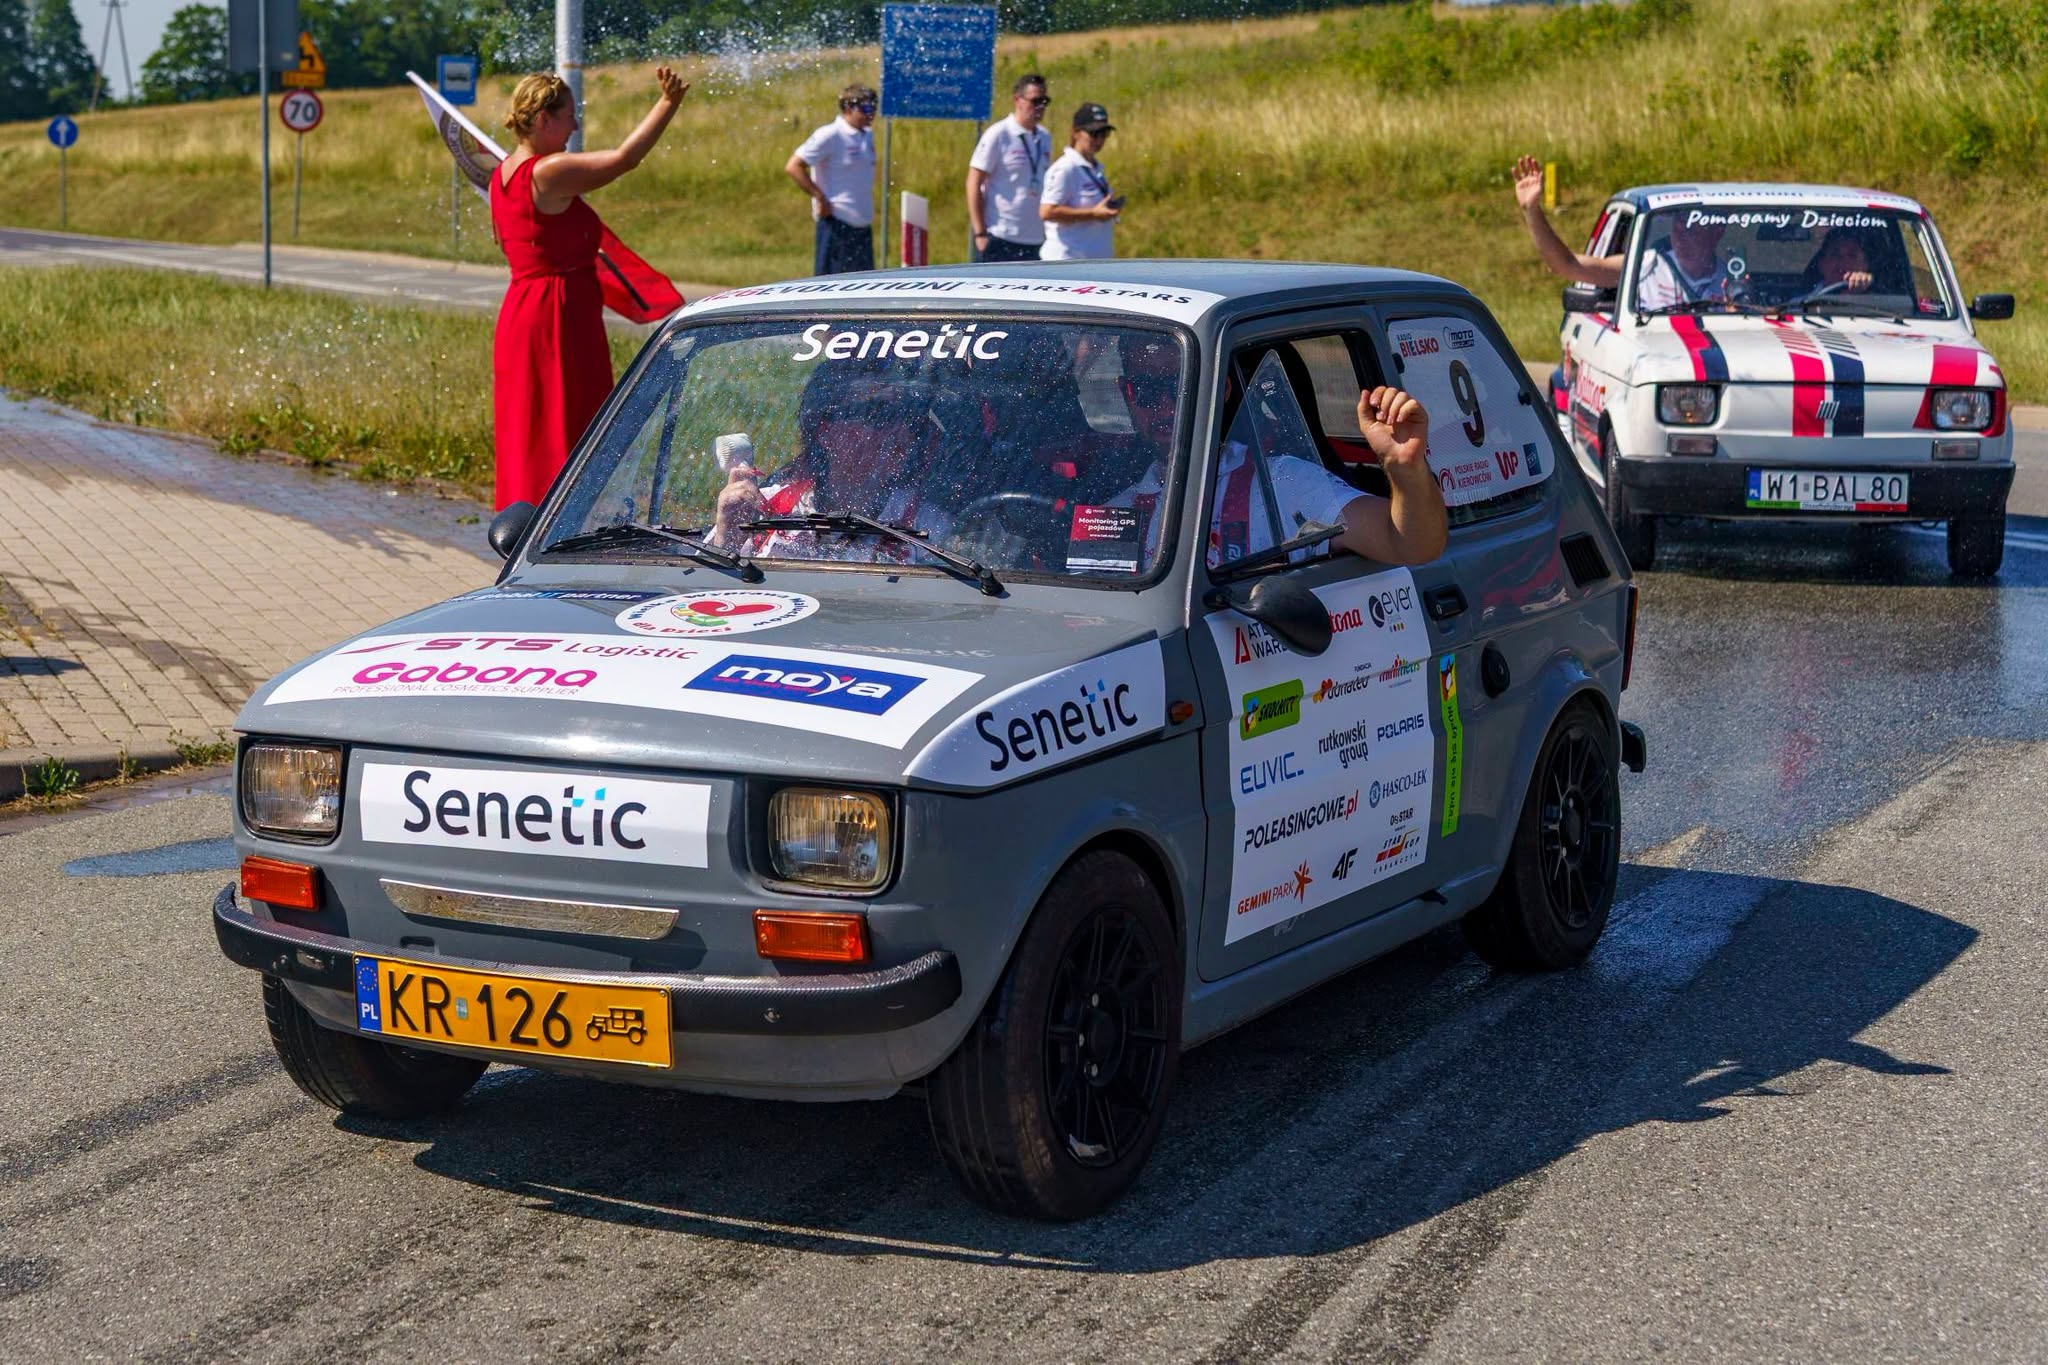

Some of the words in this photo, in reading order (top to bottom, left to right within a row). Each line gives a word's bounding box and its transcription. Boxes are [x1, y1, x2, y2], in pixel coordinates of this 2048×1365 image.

[290, 100, 317, 122] 70
[1686, 210, 1791, 229] Pomagamy
[1801, 210, 1889, 229] Dzieciom
[978, 283, 1193, 304] STARS4STARS
[793, 323, 1009, 361] Senetic
[1400, 337, 1440, 358] BIELSKO
[1449, 359, 1485, 448] 9
[1767, 474, 1797, 501] W1
[1078, 517, 1118, 526] Monitoring
[1087, 524, 1125, 532] pojazdów
[557, 592, 642, 600] partner
[632, 621, 656, 631] dla
[415, 637, 565, 652] STS
[563, 641, 699, 661] Logistic
[352, 661, 598, 688] Gabona
[718, 664, 893, 699] moya
[333, 684, 431, 695] PROFESSIONAL
[431, 684, 509, 694] COSMETICS
[510, 685, 581, 696] SUPPLIER
[975, 679, 1138, 772] Senetic
[1318, 718, 1367, 754] rutkowski
[1376, 713, 1425, 742] POLARIS
[1339, 741, 1369, 769] group
[1382, 768, 1427, 799] HASCO-LEK
[403, 769, 648, 850] Senetic
[1244, 788, 1359, 854] POLEASINGOWE.pl
[1331, 847, 1359, 881] 4F
[1236, 888, 1272, 916] GEMINI
[1272, 880, 1294, 902] PARK
[361, 1002, 379, 1021] PL
[386, 972, 455, 1039] KR
[476, 987, 573, 1049] 126
